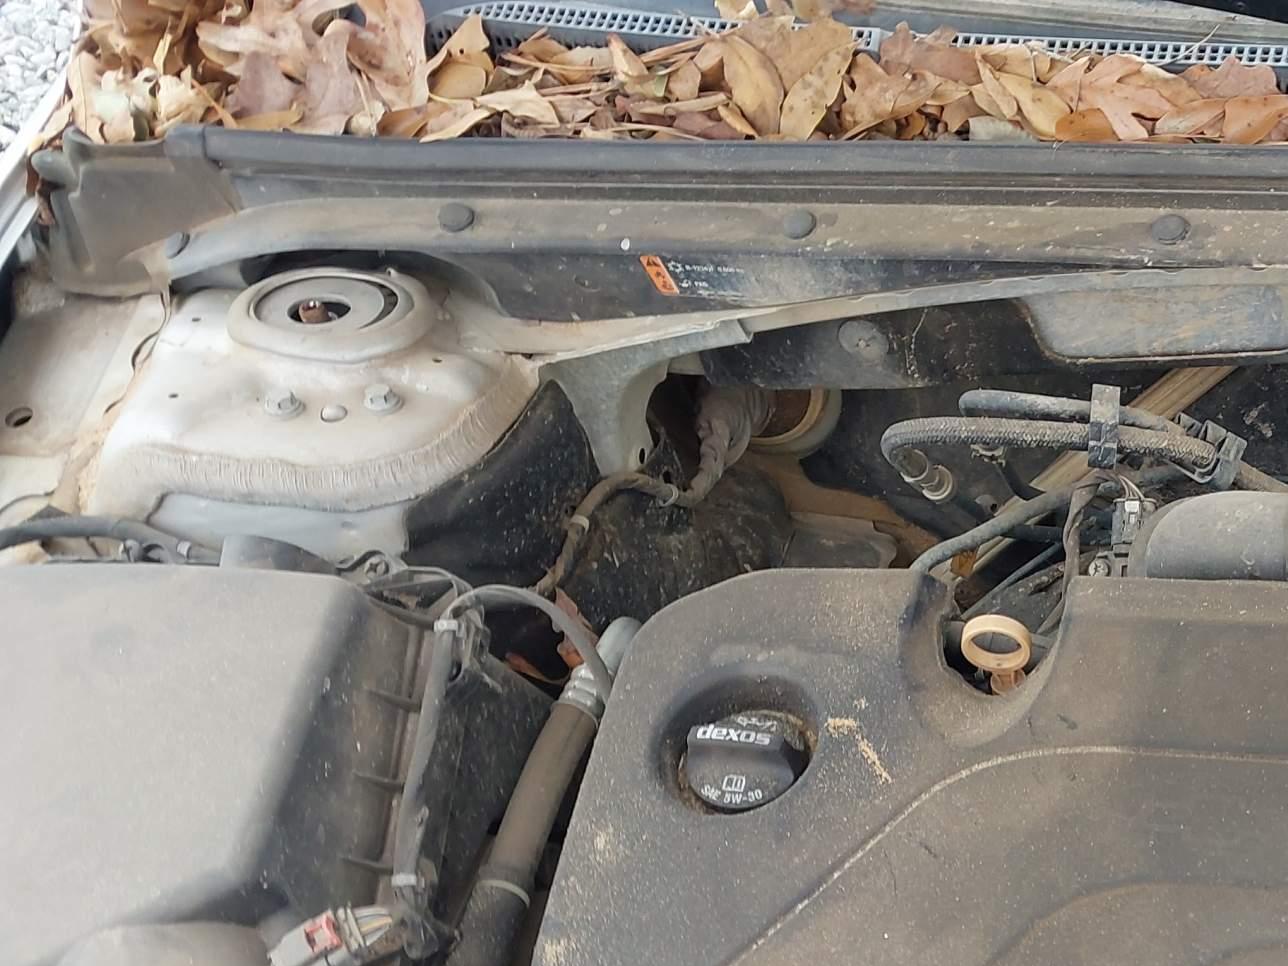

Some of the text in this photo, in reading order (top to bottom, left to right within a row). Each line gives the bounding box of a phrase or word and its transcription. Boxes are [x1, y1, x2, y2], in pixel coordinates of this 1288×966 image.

[696, 723, 771, 746] dexos
[701, 783, 763, 804] SAE 5W-30
